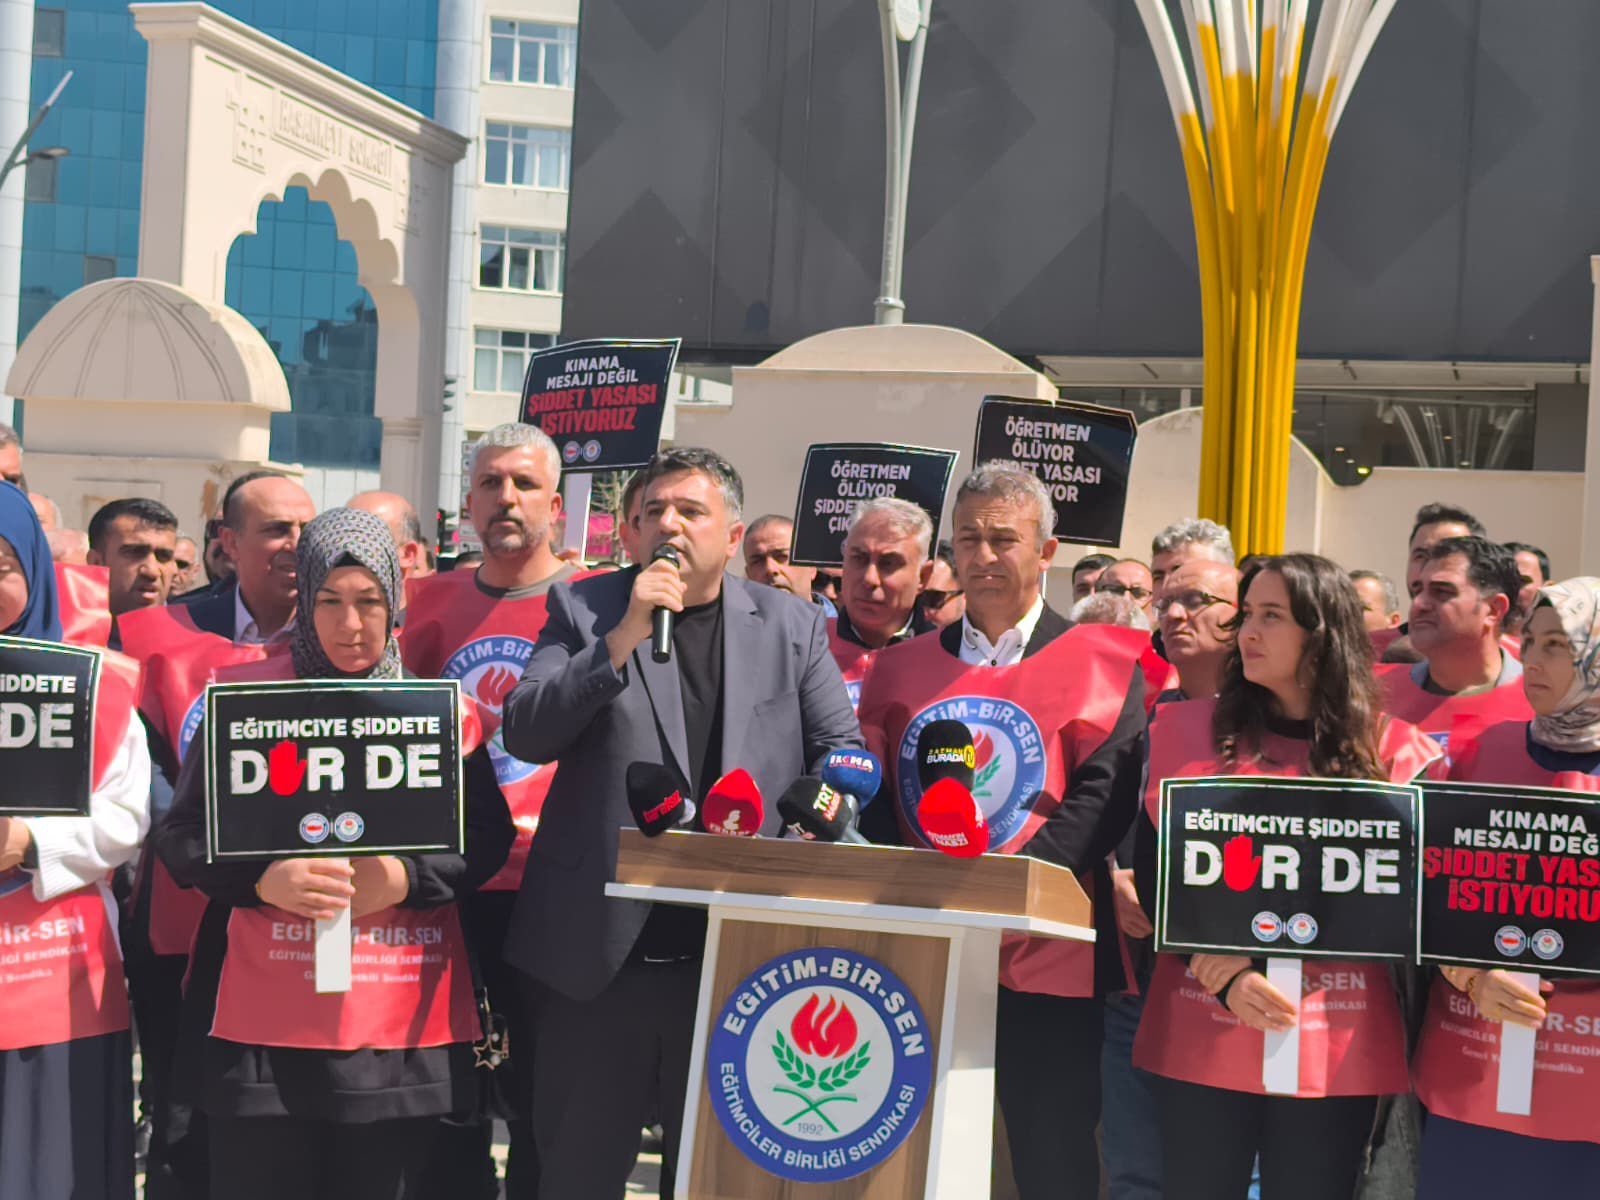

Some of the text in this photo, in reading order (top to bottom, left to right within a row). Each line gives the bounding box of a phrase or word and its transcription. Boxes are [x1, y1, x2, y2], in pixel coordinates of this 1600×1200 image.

[565, 355, 620, 373] KINAMA
[546, 367, 639, 390] MESAJI DEĞİL
[528, 383, 658, 416] ŞİDDET YASASI
[541, 407, 638, 436] İSTİYORUZ
[1005, 416, 1091, 442] ÖĞRETMEN
[1012, 438, 1075, 462] ÖLÜYOR
[831, 460, 911, 481] ÖĞRETMEN
[1043, 464, 1102, 484] YASASI
[838, 479, 897, 498] ÖLÜYOR
[814, 499, 856, 516] ŞİDDE
[0, 673, 77, 694] İDDETE
[0, 702, 74, 749] DE
[230, 718, 347, 740] EĞİTİMCİYE
[351, 716, 440, 739] ŞİDDETE
[365, 743, 442, 790] DE
[813, 783, 834, 812] TRT
[1185, 808, 1400, 840] EĞİTİMCİYE ŞİDDETE
[1489, 809, 1587, 834] KINAMA
[1454, 827, 1600, 856] MESAJI DEĞ
[1321, 846, 1400, 894] DE
[1424, 846, 1600, 888] ŞİDDET YAS
[1448, 878, 1600, 922] İSTİYORU
[723, 957, 926, 1057] EĞİTİM-BİR-SEN
[720, 1062, 917, 1170] EĞİTİMCİLER BİRLİĞİ SENDİKASI
[797, 1122, 824, 1137] 1992
